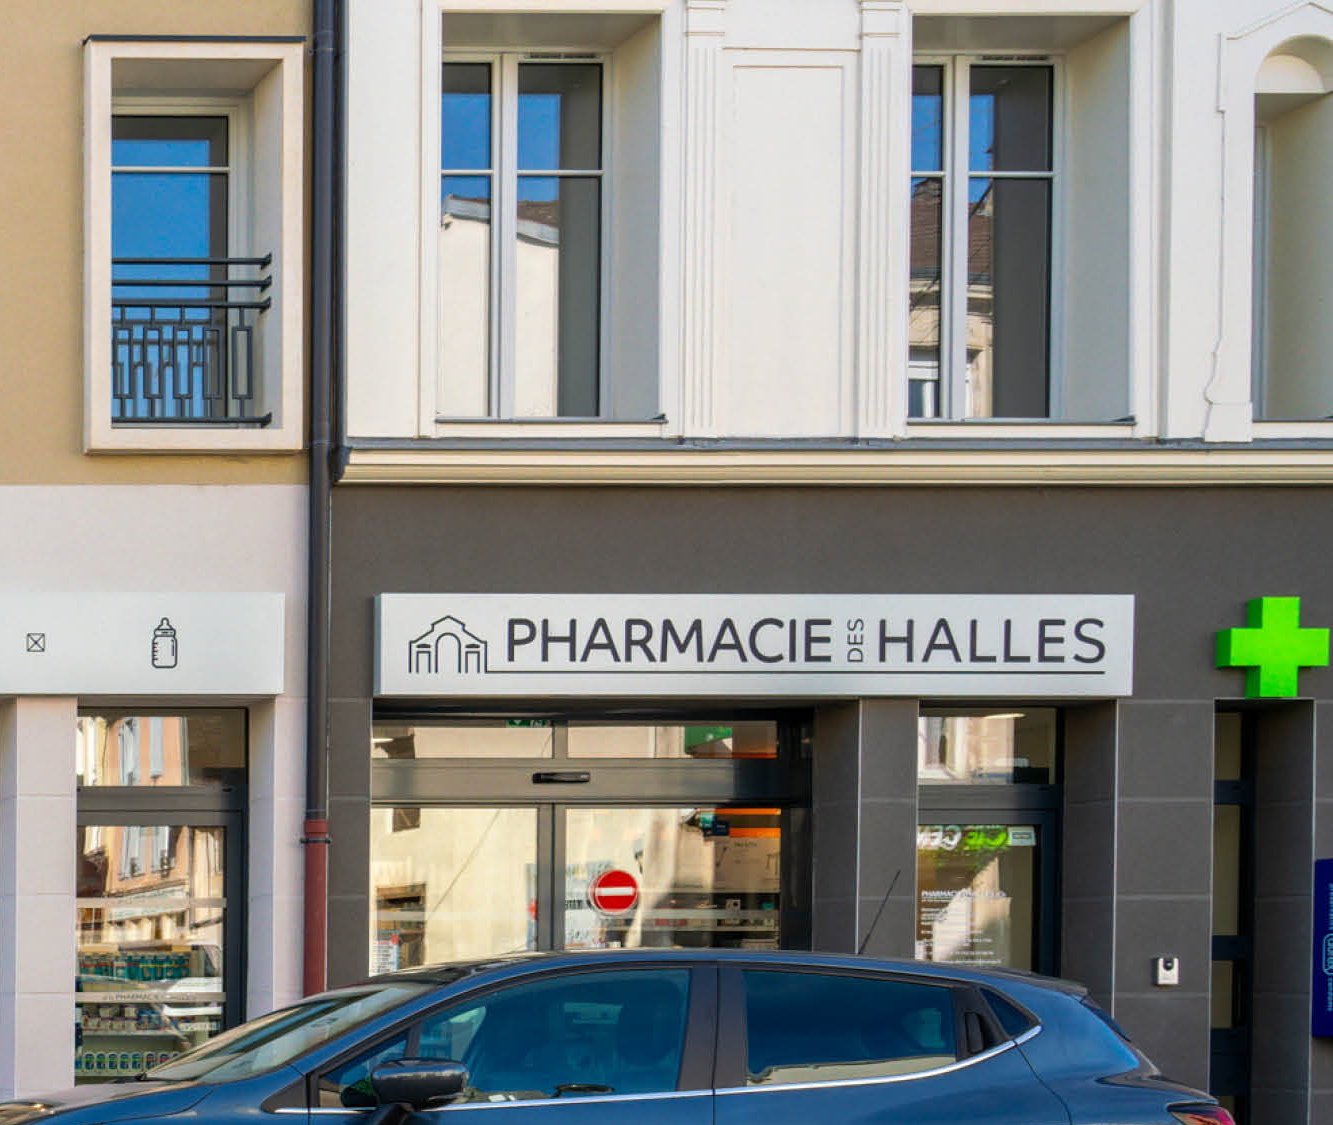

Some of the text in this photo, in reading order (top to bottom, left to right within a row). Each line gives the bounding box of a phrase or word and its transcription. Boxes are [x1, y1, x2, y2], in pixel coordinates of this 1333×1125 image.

[507, 617, 1106, 664] PHARMACIE DES HALLES
